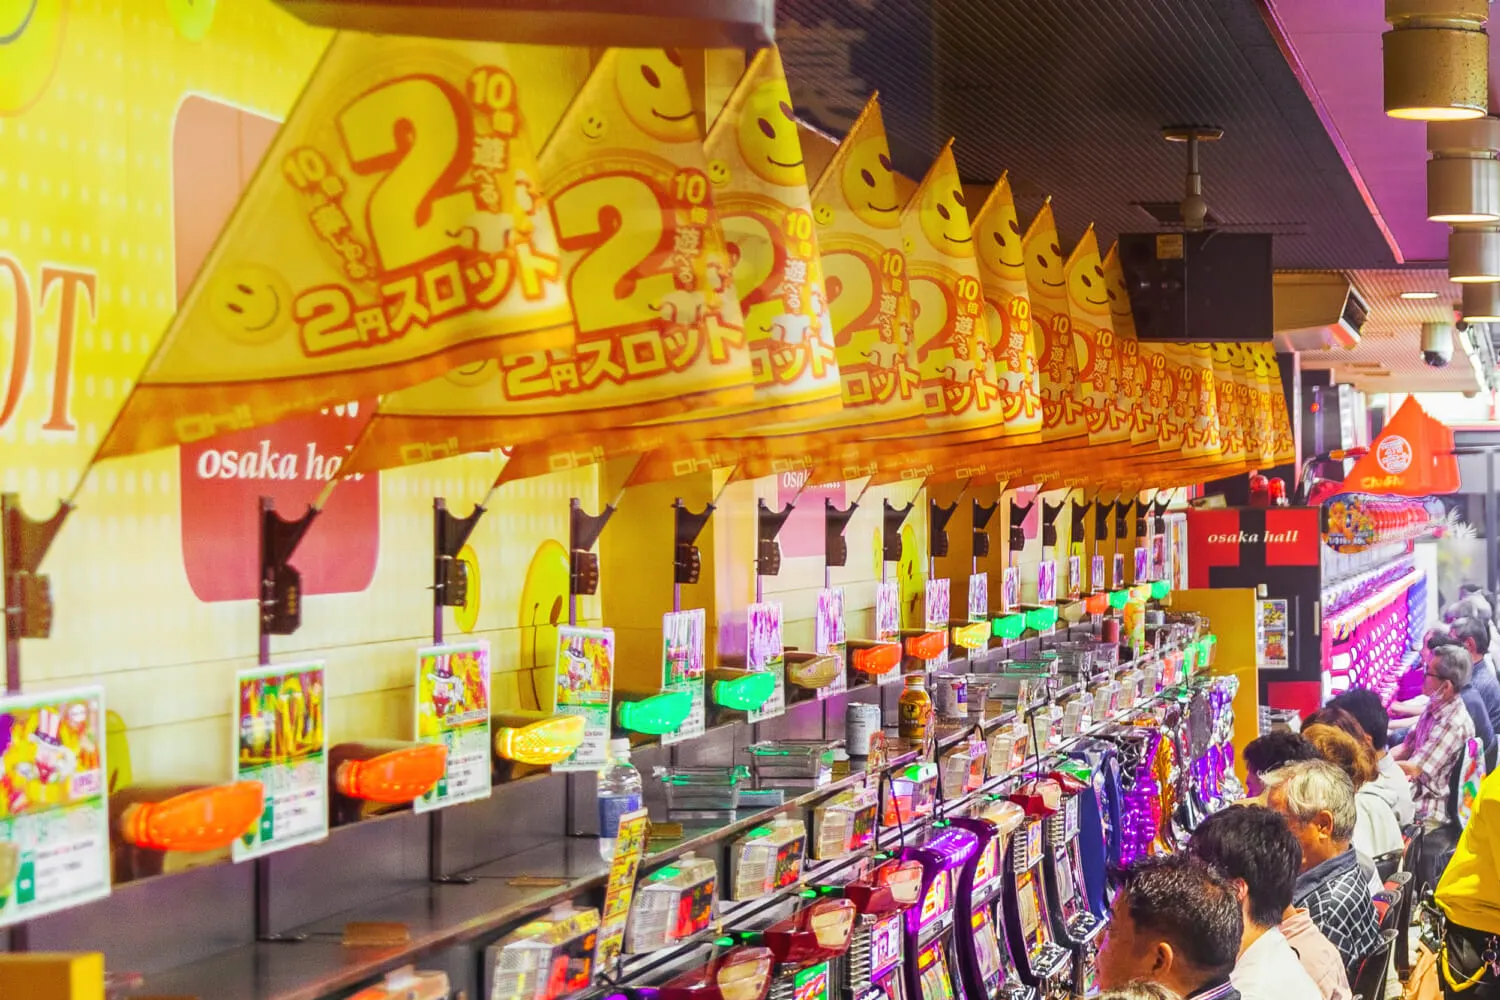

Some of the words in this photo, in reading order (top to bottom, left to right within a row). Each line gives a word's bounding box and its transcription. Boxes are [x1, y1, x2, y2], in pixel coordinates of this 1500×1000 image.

[338, 76, 479, 272] 2
[295, 243, 560, 355] 2円スロット
[553, 175, 676, 334] 2
[503, 314, 744, 398] 2円スロット
[198, 440, 298, 481] osaka
[305, 442, 365, 482] ha
[1208, 530, 1258, 543] osaka
[1264, 529, 1298, 543] hall
